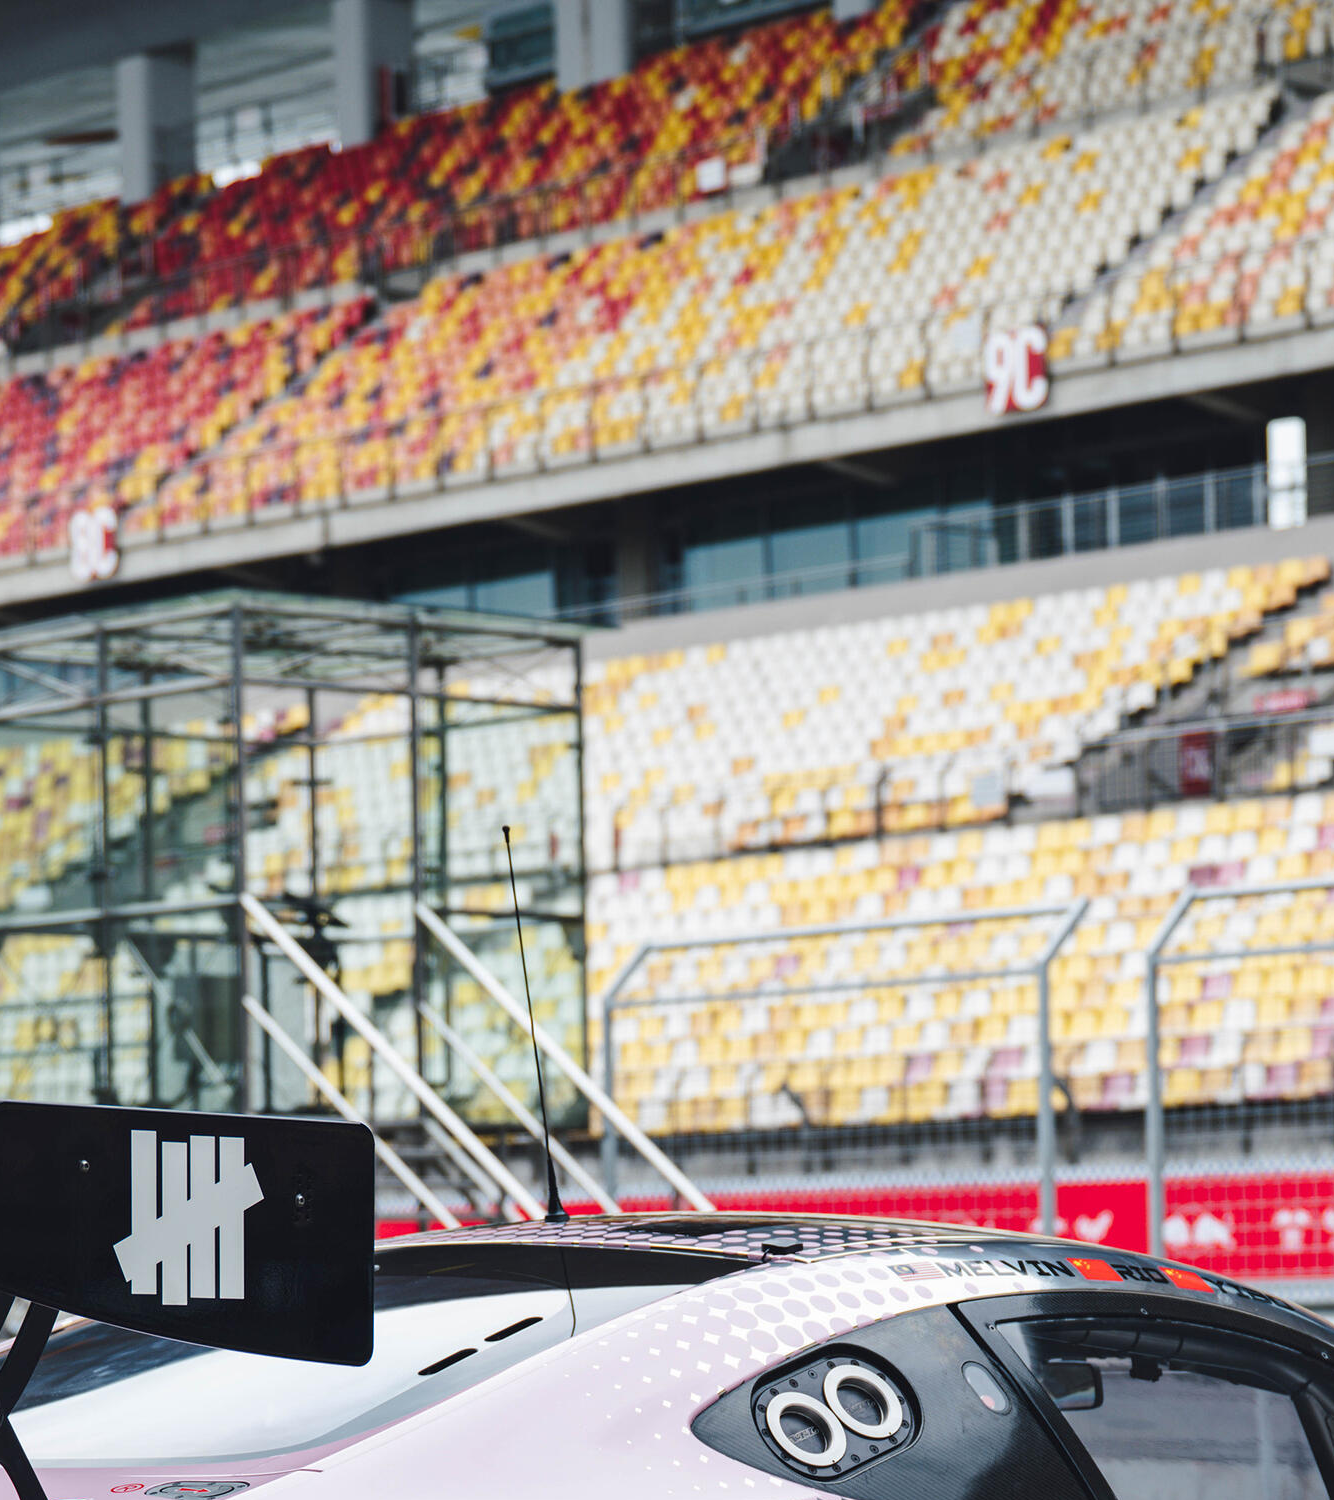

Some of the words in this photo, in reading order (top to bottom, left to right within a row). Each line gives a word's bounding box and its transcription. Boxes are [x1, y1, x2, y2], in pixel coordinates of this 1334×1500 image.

[985, 327, 1048, 414] 9C
[941, 1259, 1076, 1279] MELVIN
[1110, 1263, 1169, 1284] RIO
